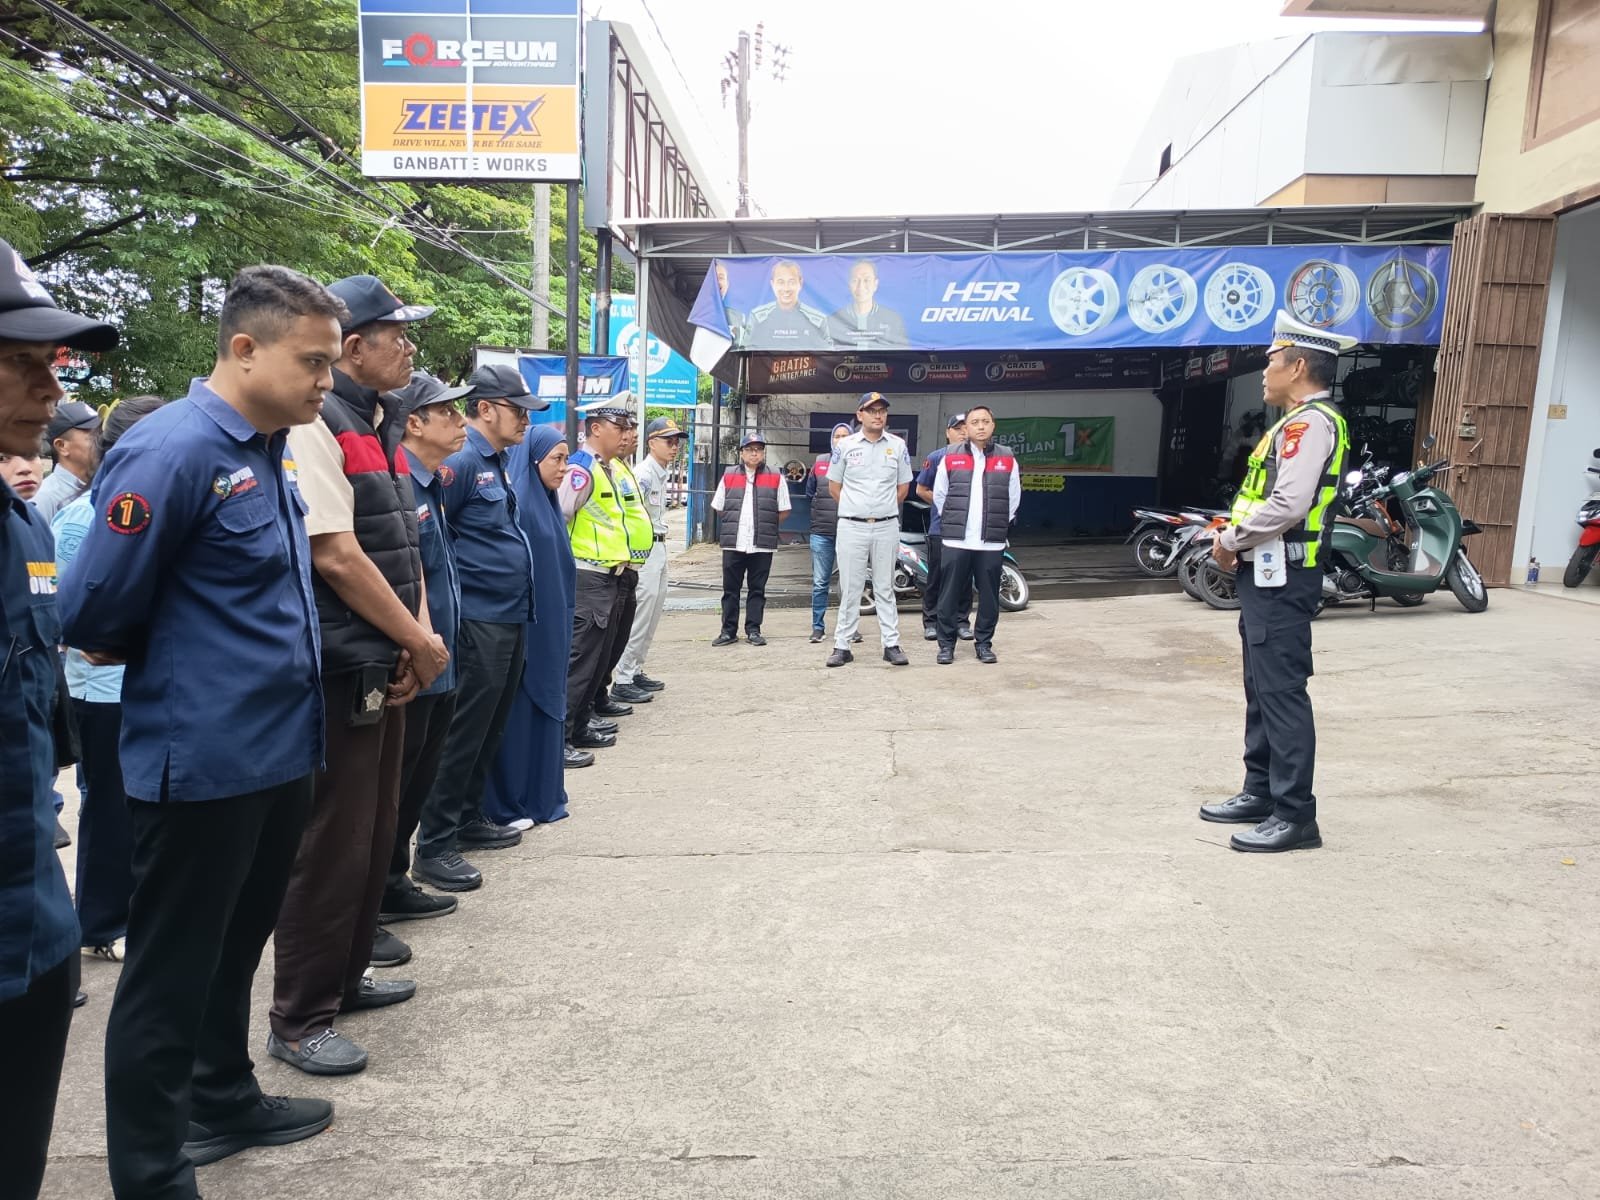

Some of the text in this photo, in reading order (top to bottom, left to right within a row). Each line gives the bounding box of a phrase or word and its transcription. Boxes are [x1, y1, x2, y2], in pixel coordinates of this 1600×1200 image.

[382, 33, 557, 66] FORCEUM
[402, 95, 547, 140] ZEETEX
[392, 138, 543, 149] DRIVE WILL NEVR BE THE SAME
[487, 157, 547, 172] WORKS
[942, 281, 1020, 302] HSR
[921, 306, 1034, 322] ORIGINAL
[773, 357, 810, 373] GRATIS
[769, 368, 817, 383] MAINTENANCE
[992, 432, 1025, 445] EBAS
[120, 500, 133, 526] 1
